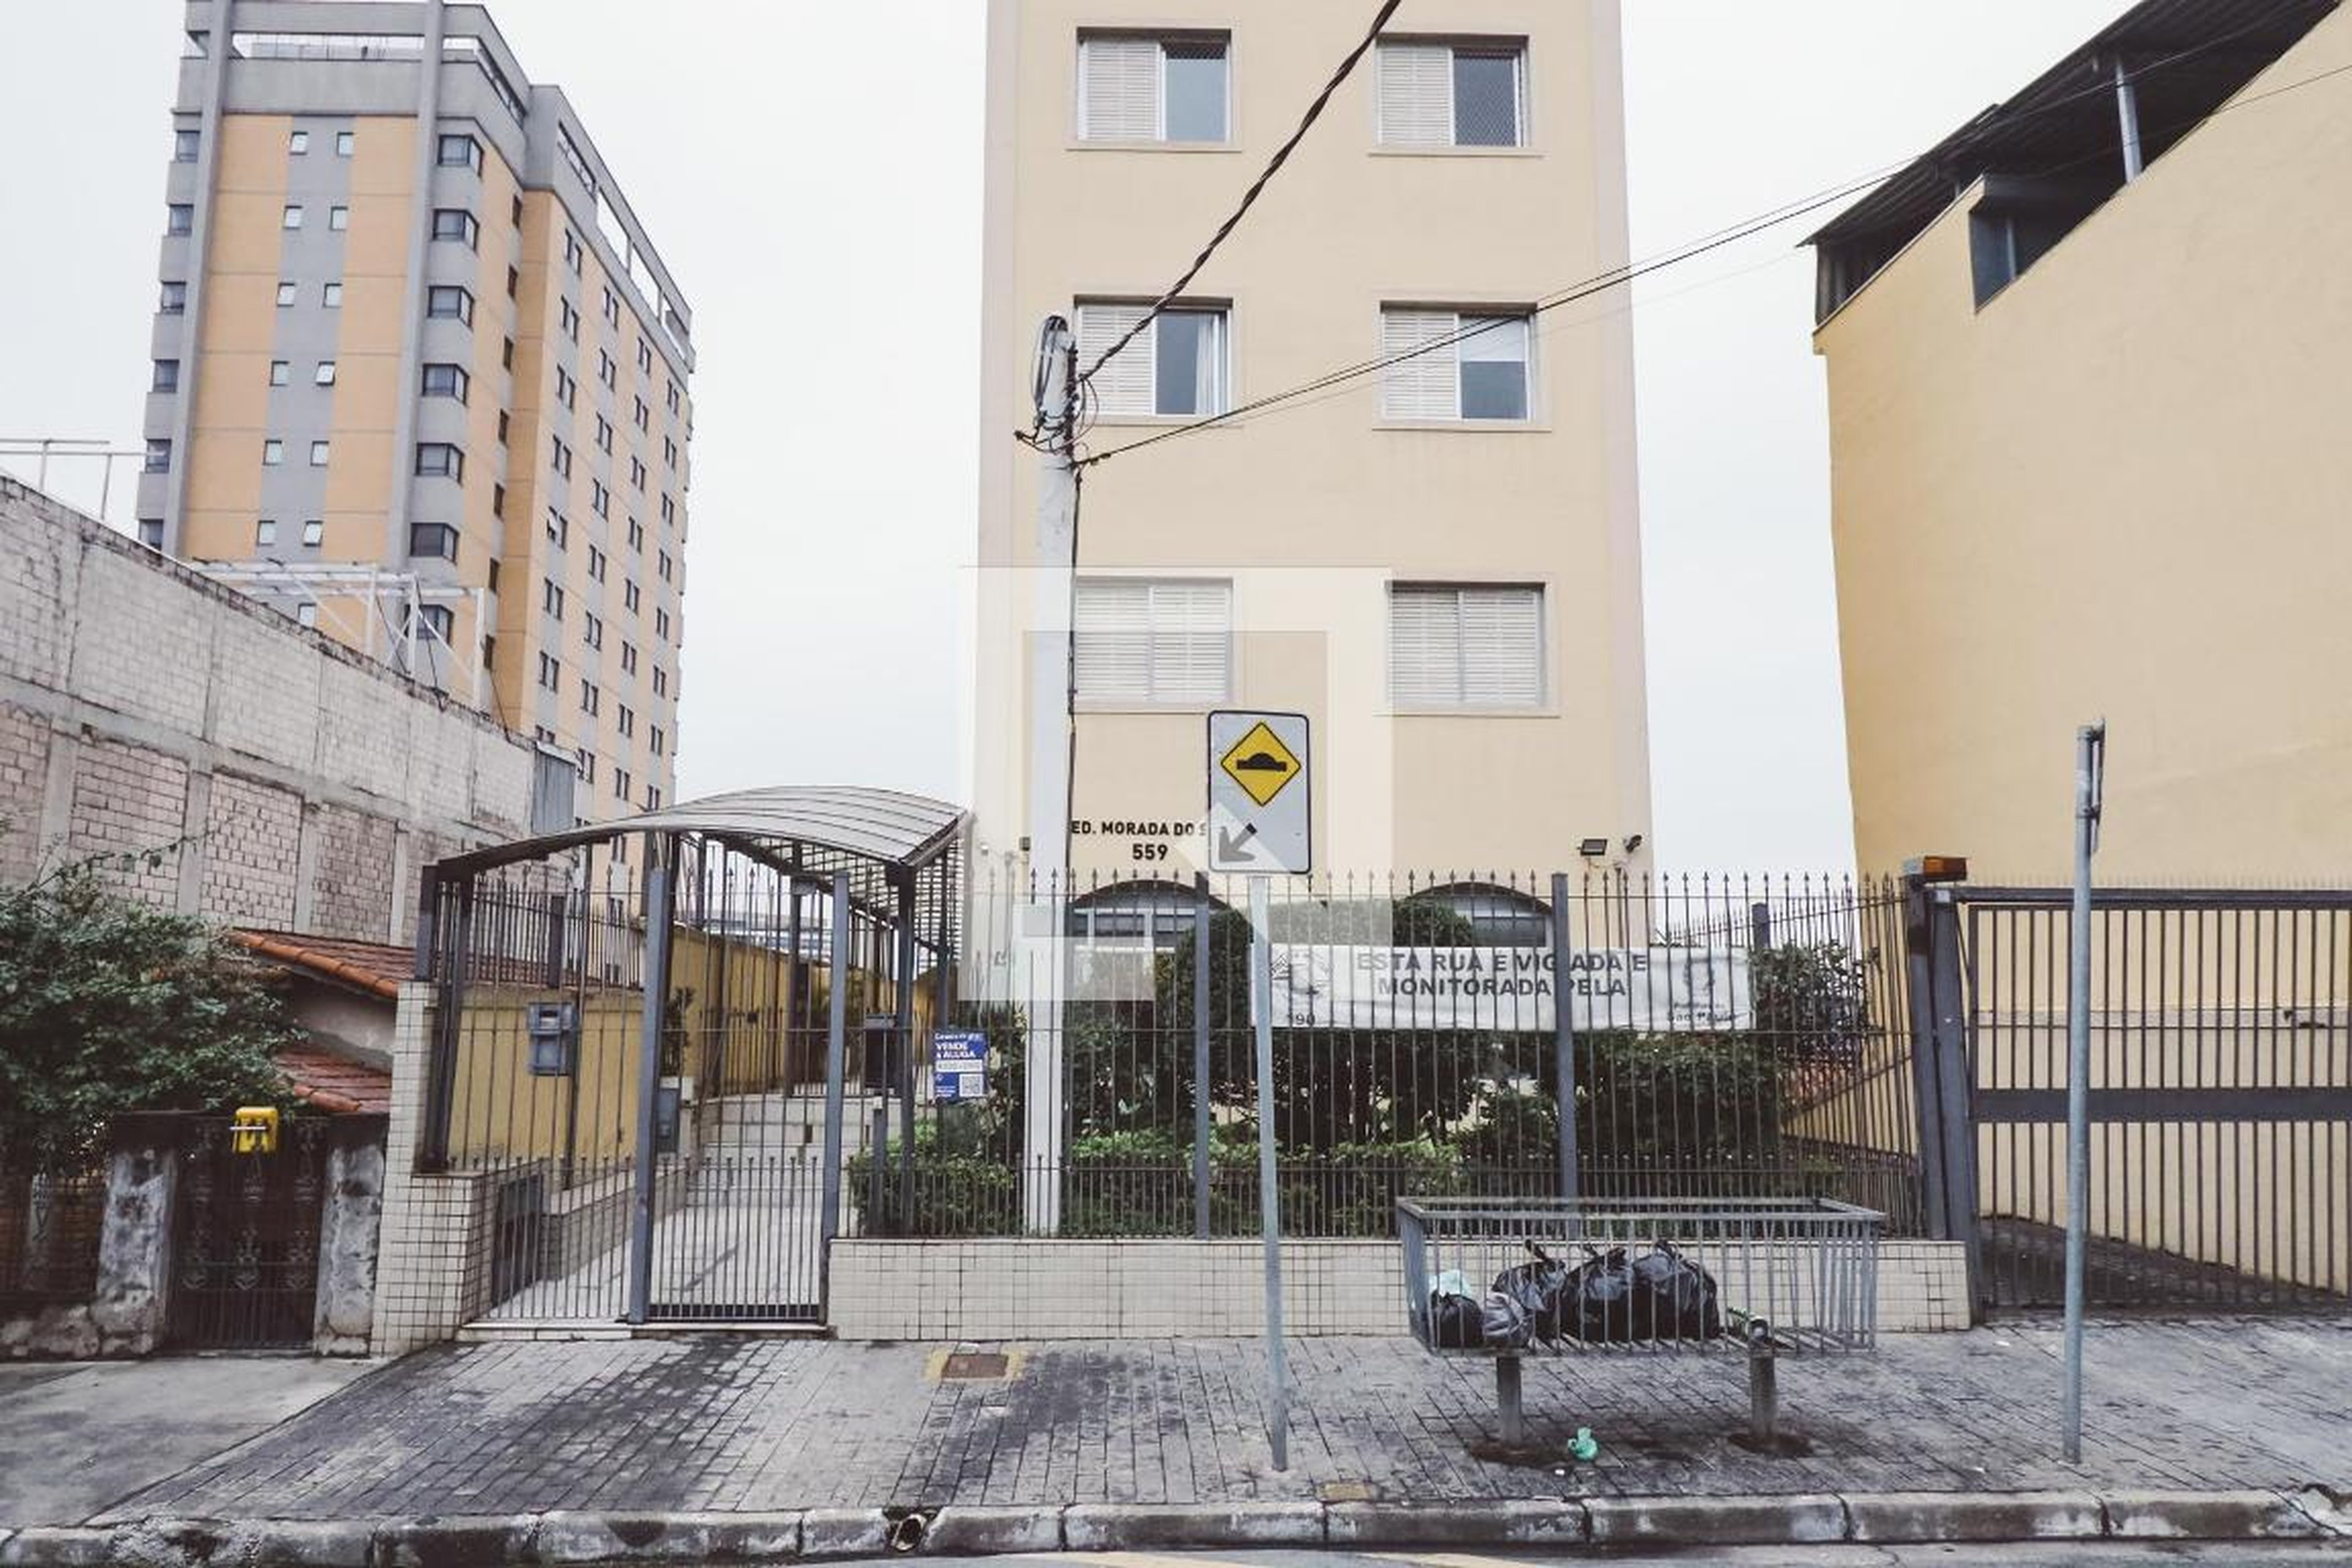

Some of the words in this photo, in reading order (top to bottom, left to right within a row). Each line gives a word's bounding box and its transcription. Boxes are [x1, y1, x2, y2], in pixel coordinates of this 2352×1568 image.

[1071, 821, 1096, 834] ED.
[1102, 821, 1169, 835] MORADA
[1133, 843, 1168, 861] 559
[1357, 952, 1421, 971] ESTA
[1432, 954, 1483, 971] RUA
[1516, 953, 1623, 971] VIGADA
[1379, 978, 1551, 996] MONITORADA
